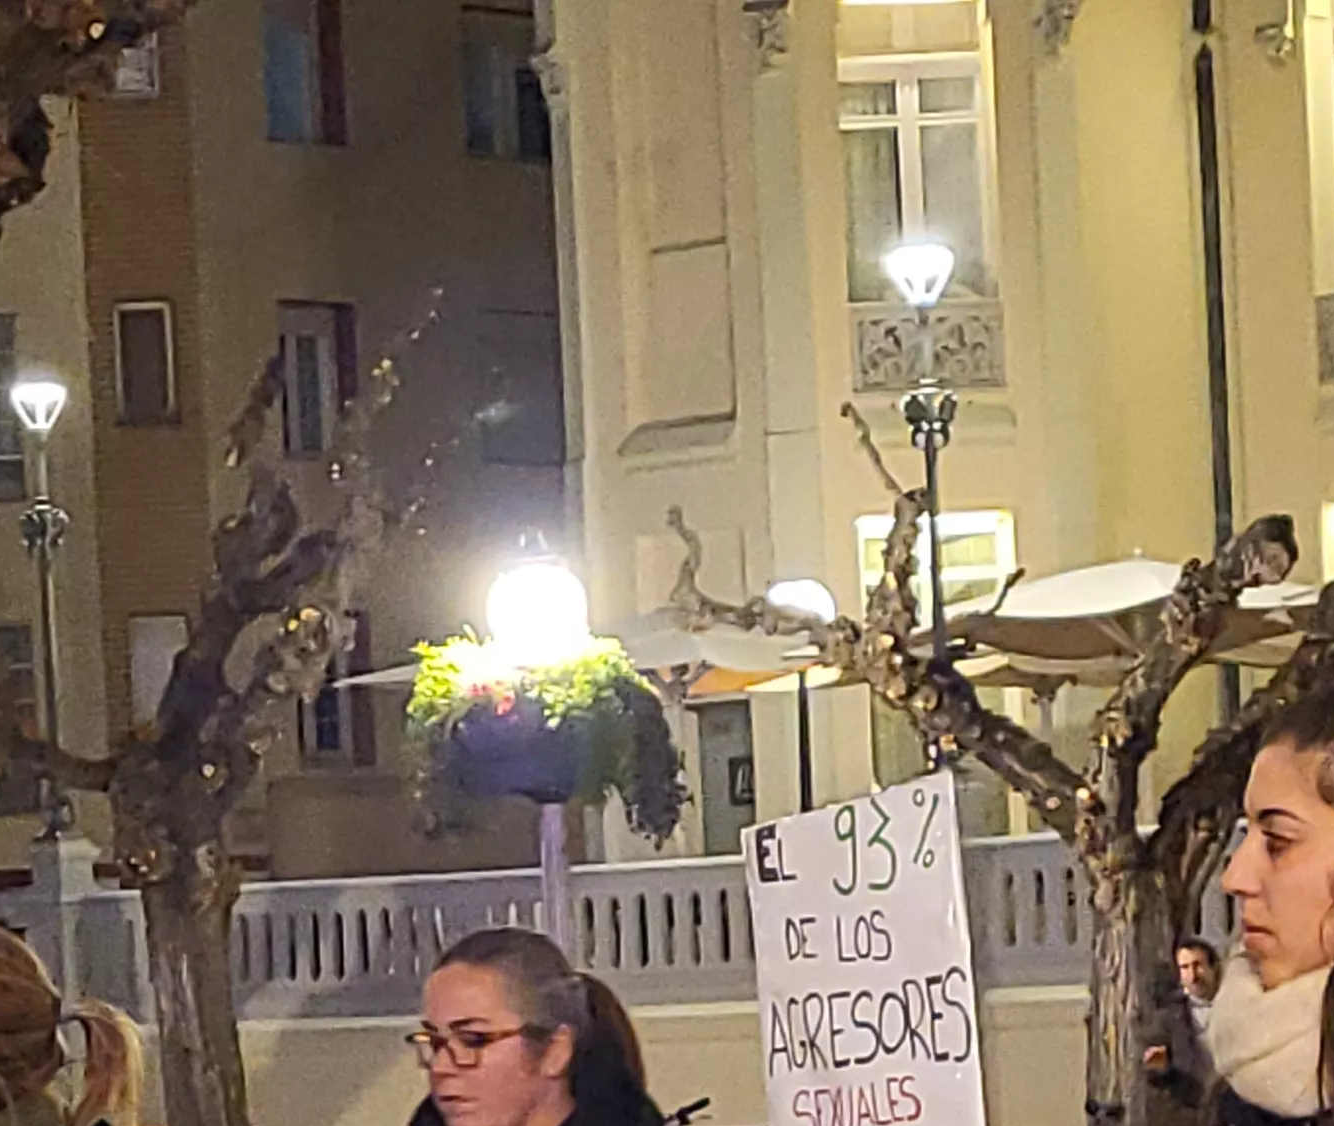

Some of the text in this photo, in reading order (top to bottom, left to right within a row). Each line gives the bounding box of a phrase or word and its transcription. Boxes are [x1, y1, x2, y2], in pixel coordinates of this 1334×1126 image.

[754, 823, 797, 884] EL
[784, 908, 893, 963] DE LOS
[767, 964, 973, 1078] AGRESORES
